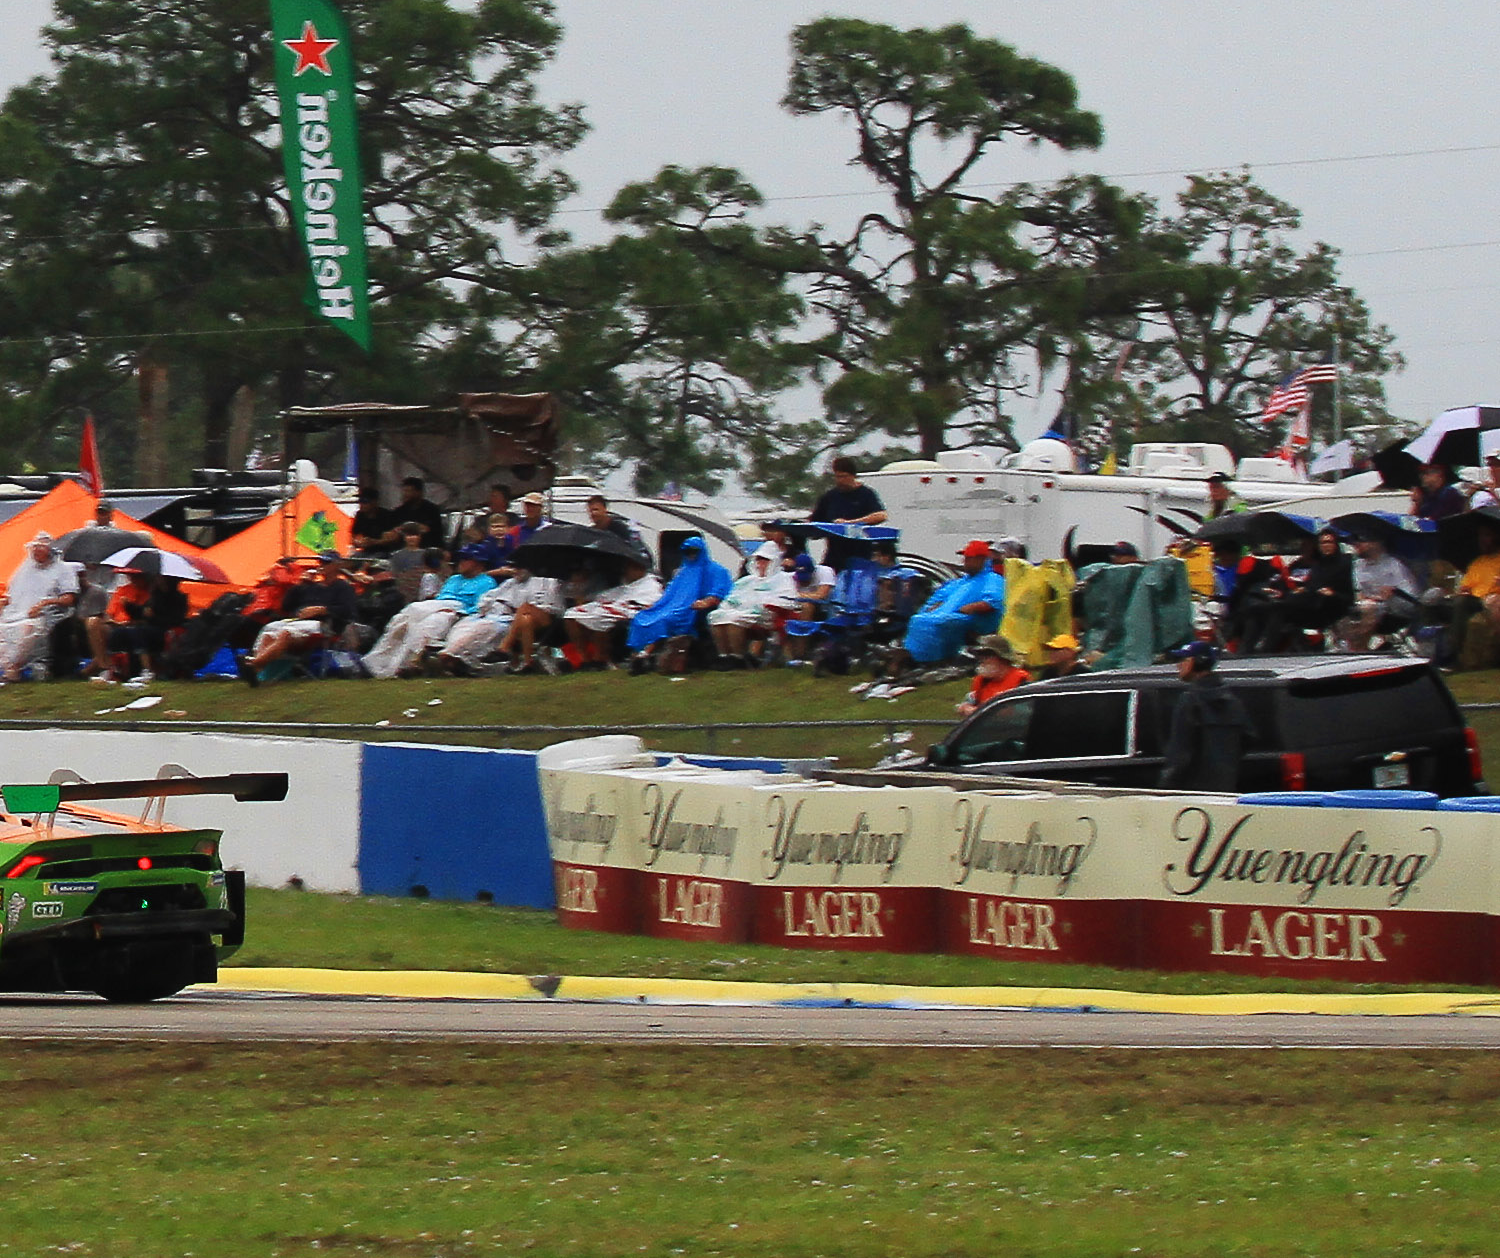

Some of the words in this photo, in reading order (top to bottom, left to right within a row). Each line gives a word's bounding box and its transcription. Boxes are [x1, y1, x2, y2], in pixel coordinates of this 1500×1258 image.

[1161, 806, 1444, 907] Yuengling
[36, 906, 60, 916] GTD
[784, 891, 885, 937] LAGER
[969, 898, 1059, 950] LAGER
[1208, 908, 1387, 961] LAGER
